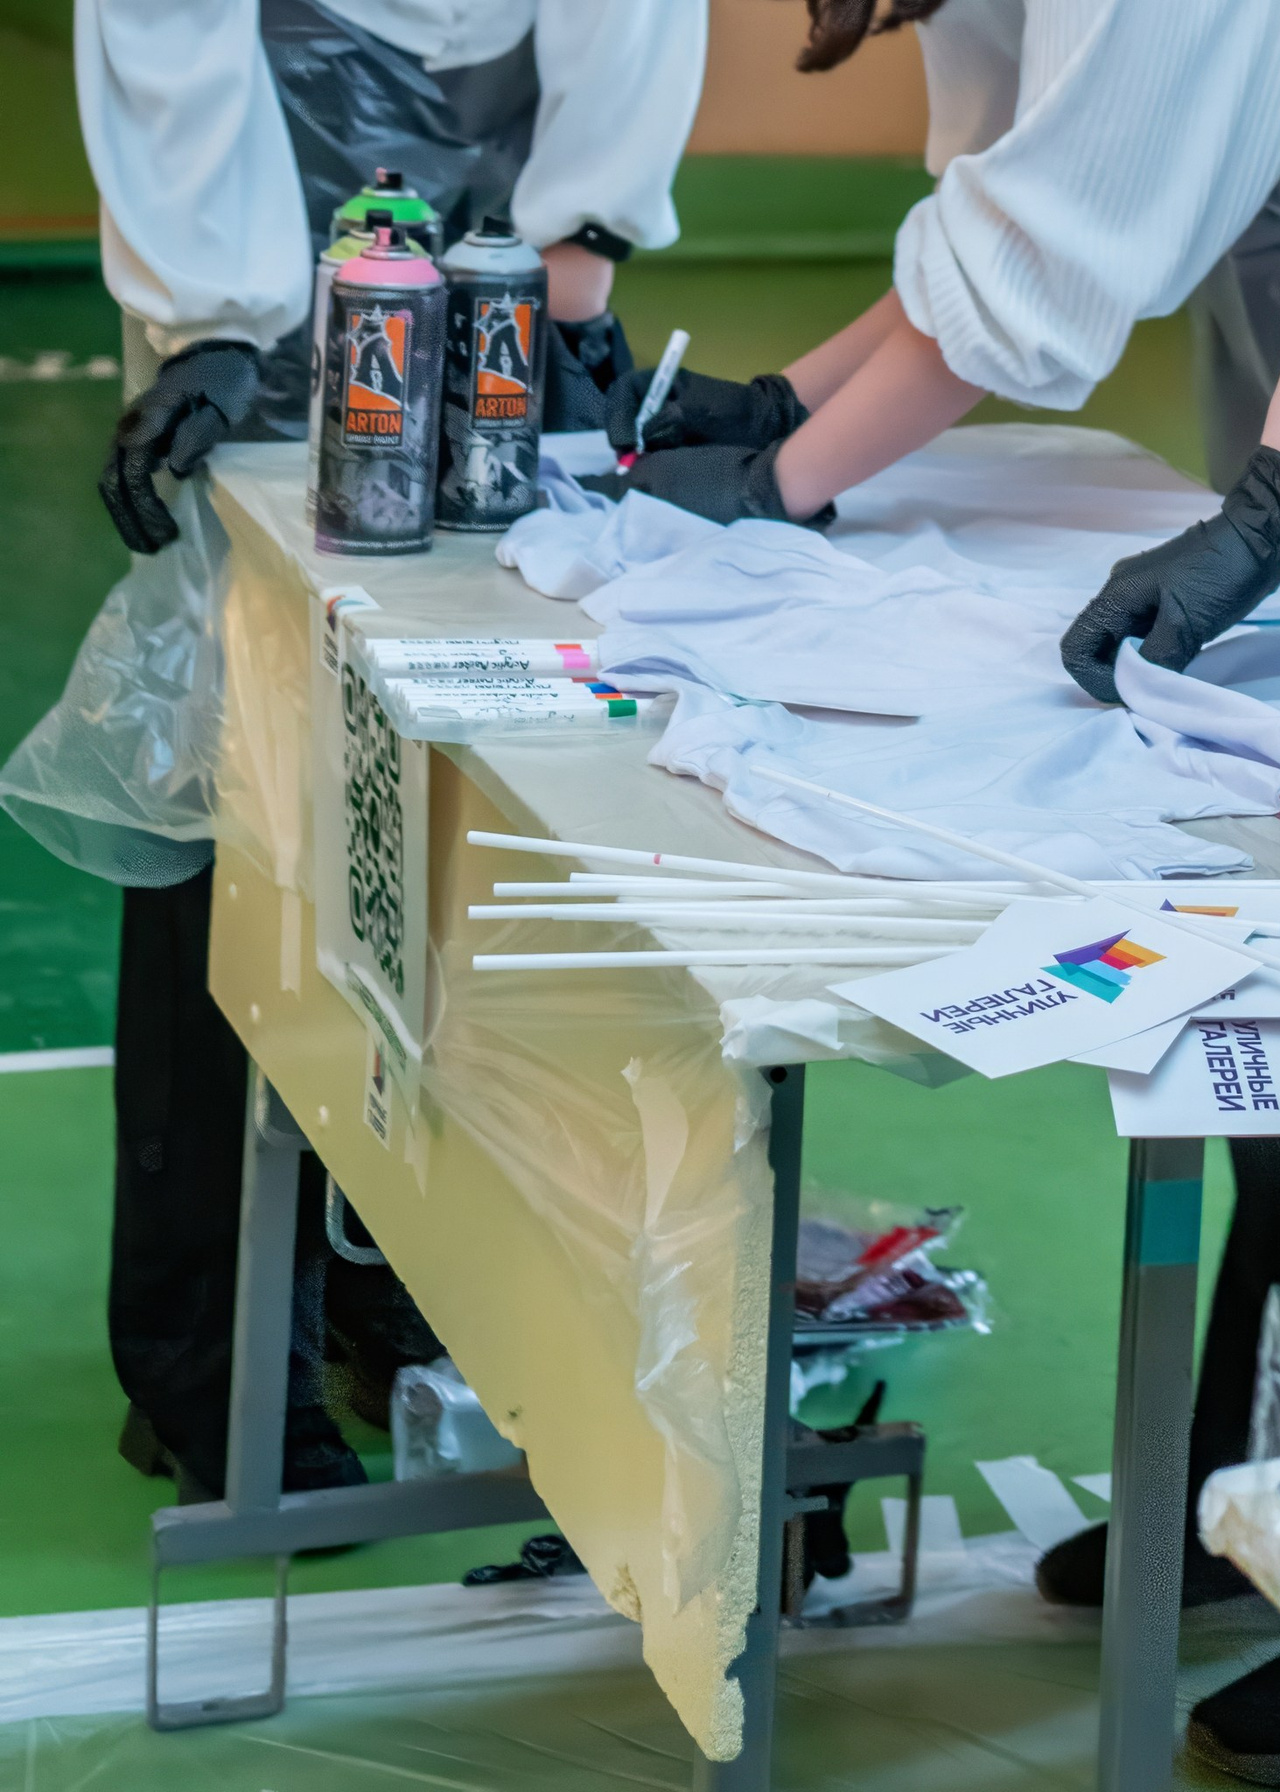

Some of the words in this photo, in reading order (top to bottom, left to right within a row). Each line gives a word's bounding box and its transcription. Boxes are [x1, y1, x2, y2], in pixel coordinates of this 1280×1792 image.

[345, 411, 403, 434] ARTON
[474, 396, 527, 418] ARTON
[919, 978, 1057, 1023] ГАЛЕРЕИ
[942, 990, 1079, 1034] УЛИЧНЫЕ
[1196, 1020, 1247, 1111] ГАЛЕРЕИ
[1231, 1020, 1280, 1111] УЛИЧНЫЕ
